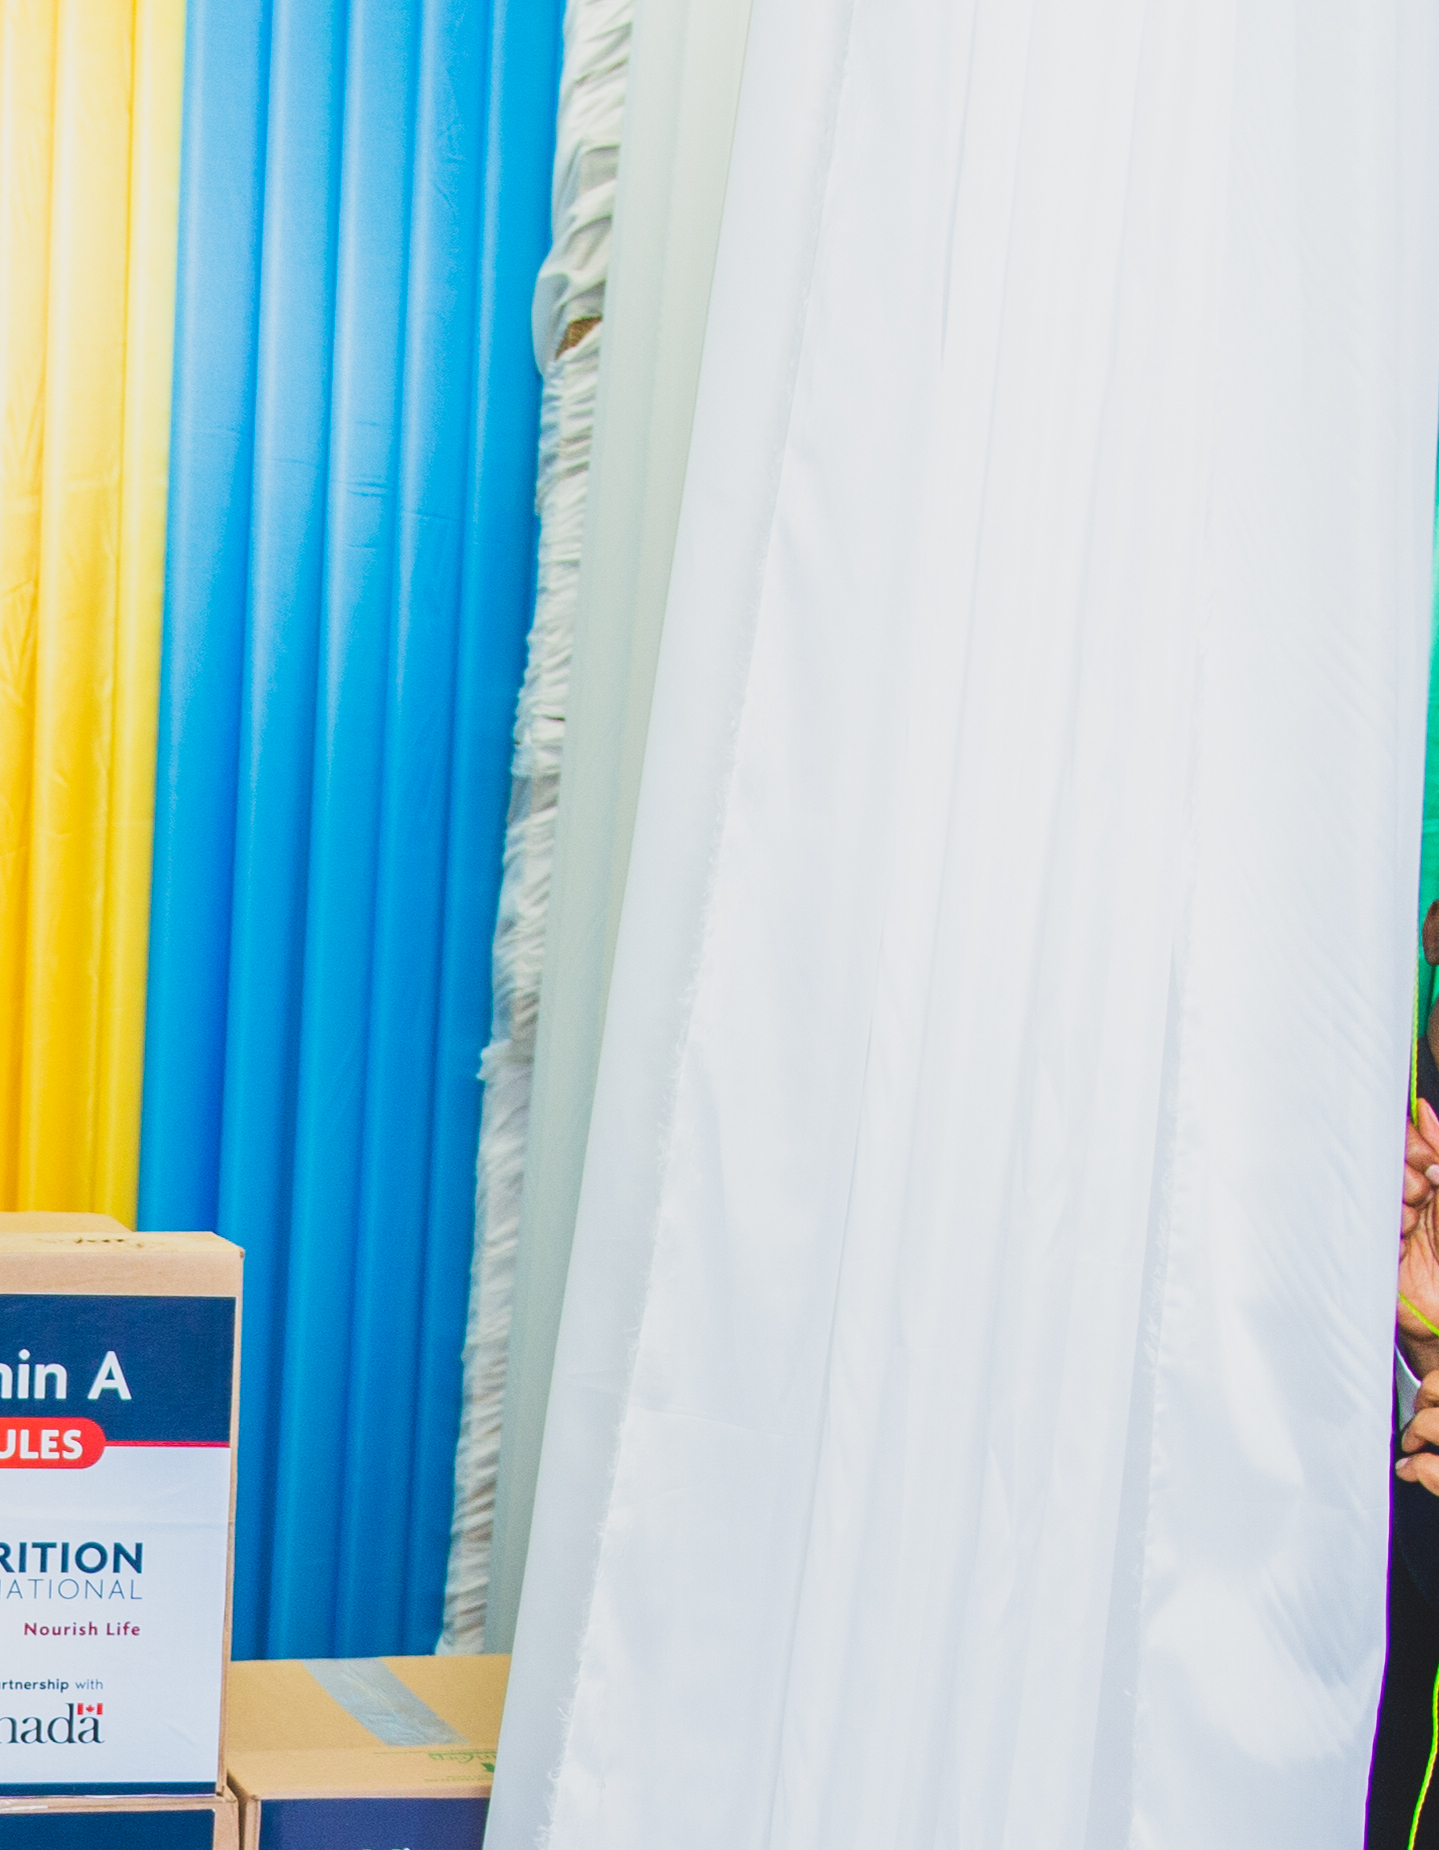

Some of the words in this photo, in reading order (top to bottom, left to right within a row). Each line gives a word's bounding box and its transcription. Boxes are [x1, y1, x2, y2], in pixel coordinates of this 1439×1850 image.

[88, 1351, 131, 1399] A
[24, 1622, 98, 1636] Nourish
[106, 1622, 140, 1636] Life
[74, 1679, 103, 1690] with
